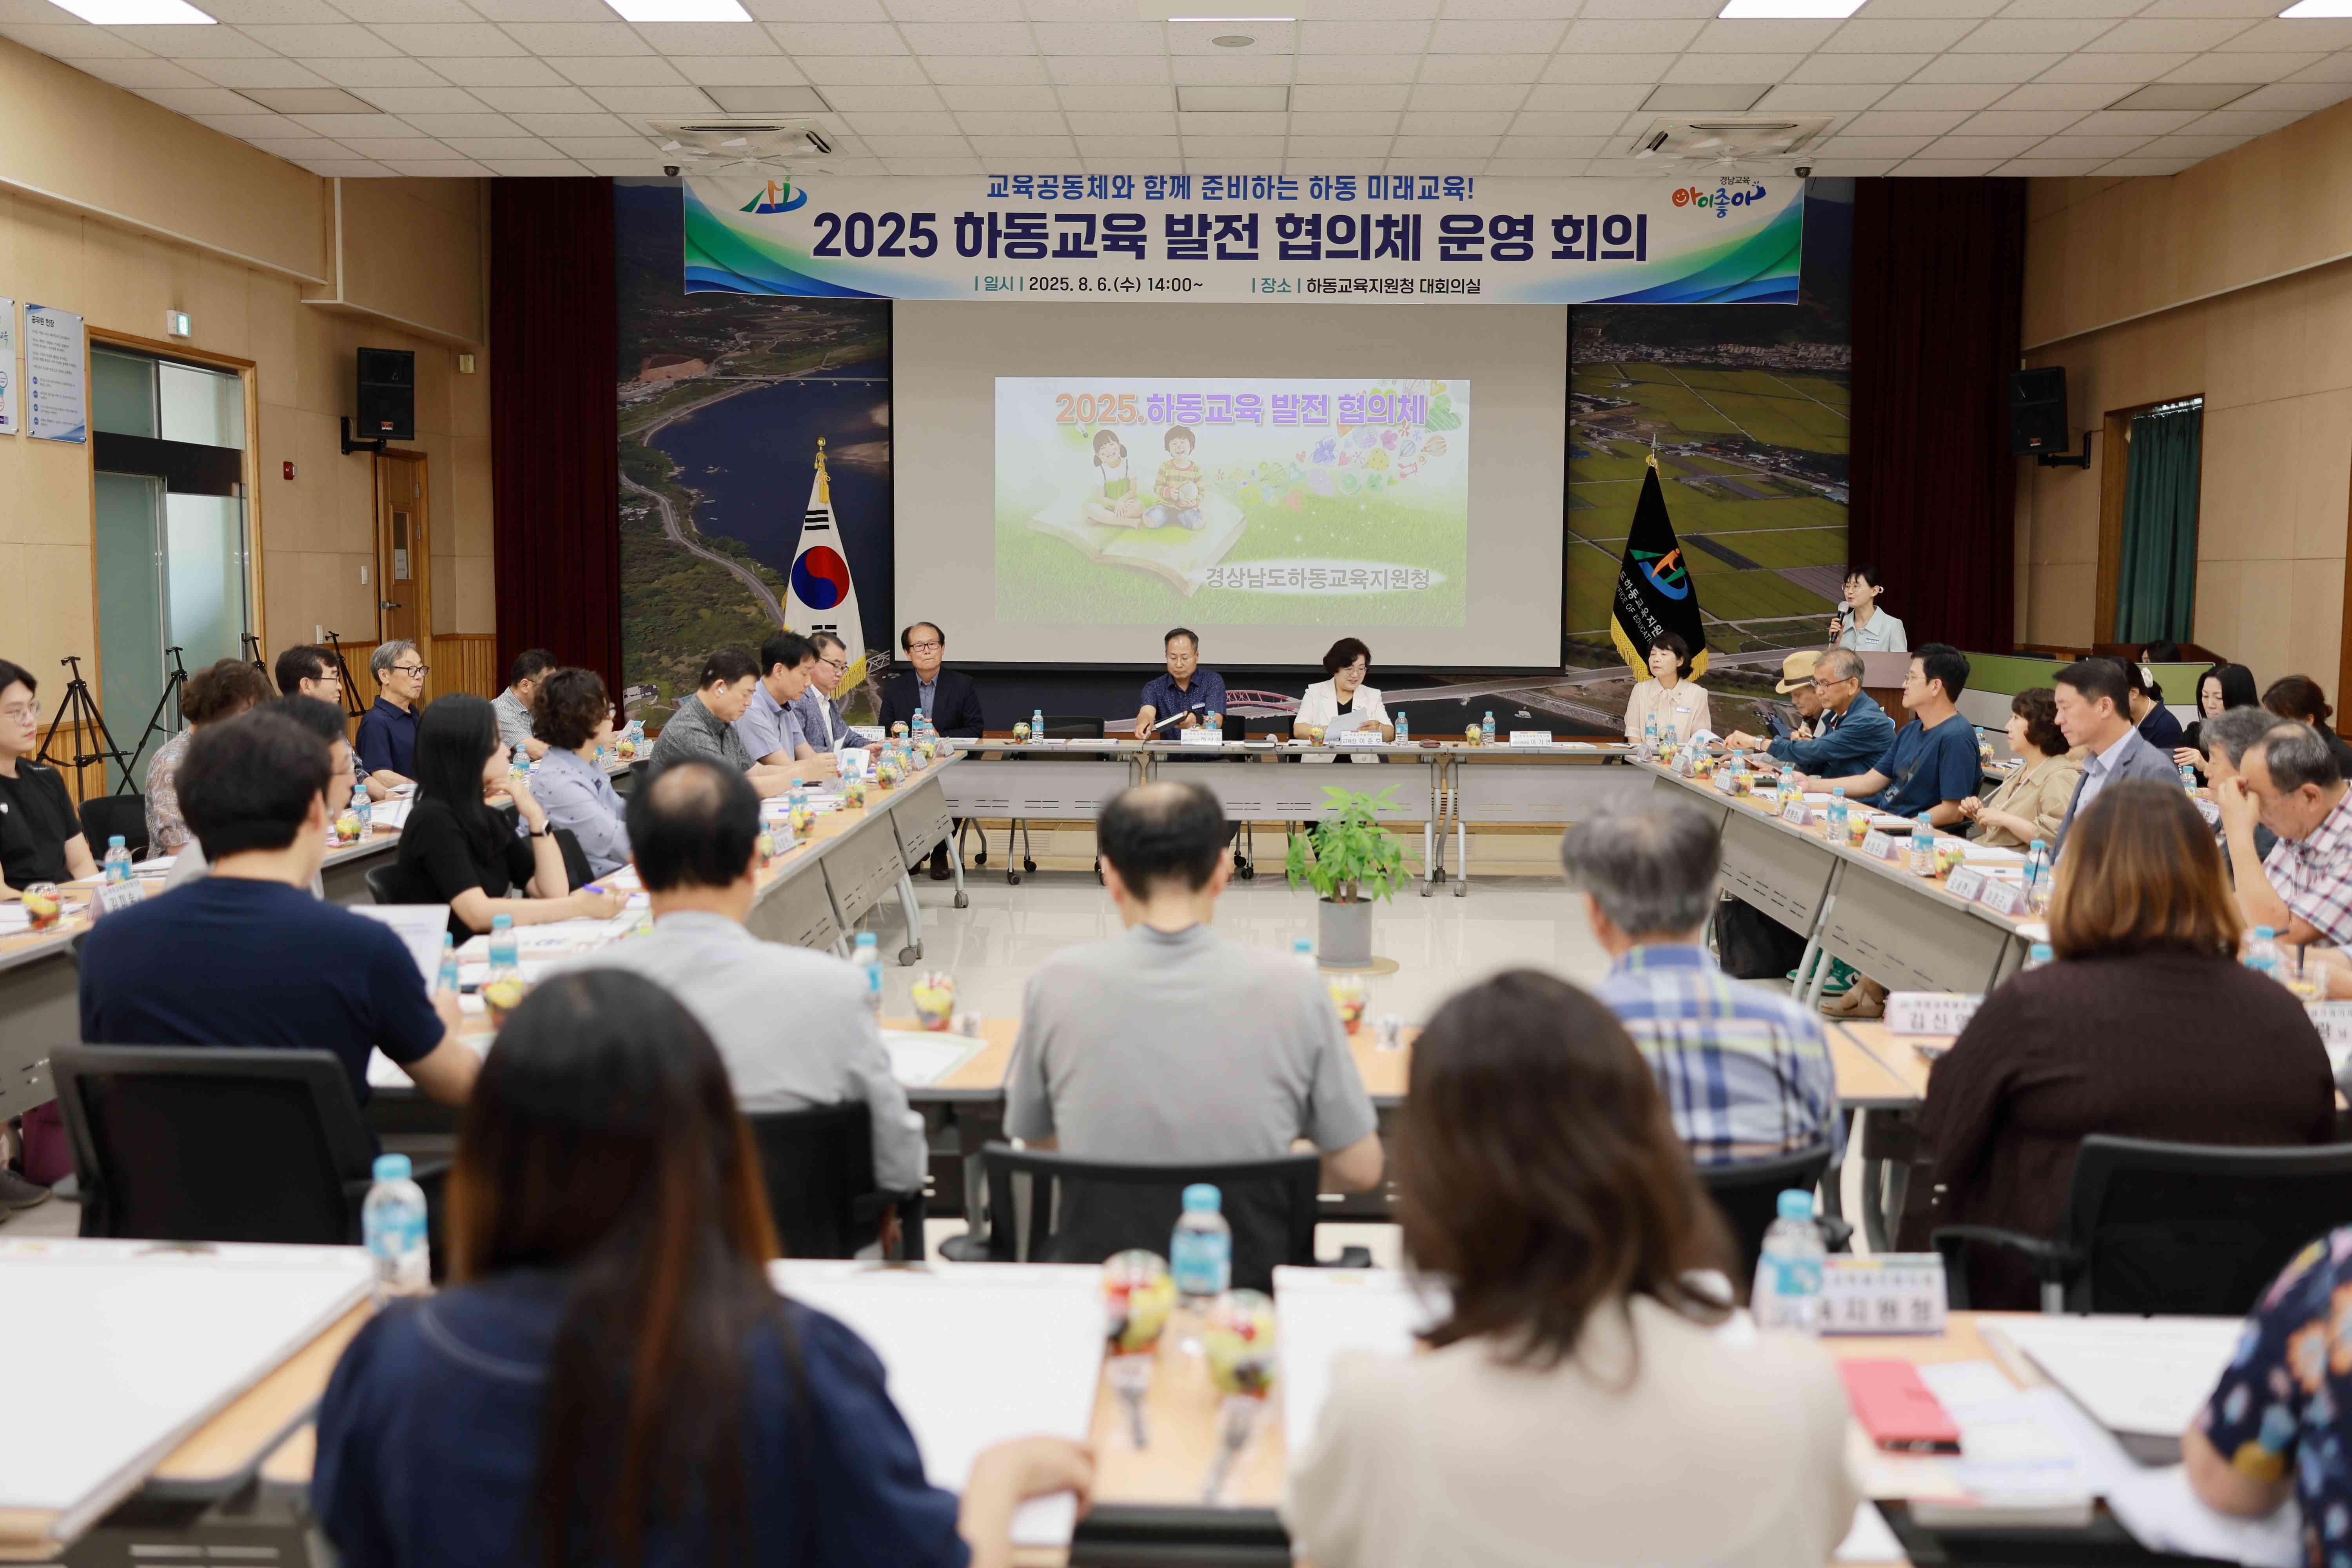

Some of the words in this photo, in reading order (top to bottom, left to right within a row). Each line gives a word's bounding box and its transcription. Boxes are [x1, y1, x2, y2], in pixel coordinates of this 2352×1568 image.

[987, 176, 1136, 200] 교육공동체와
[1144, 176, 1191, 200] 함께
[1202, 176, 1299, 201] 준비하는
[1310, 176, 1357, 201] 하동
[1368, 176, 1474, 201] 미래교육!
[1720, 176, 1750, 185] 경남교육
[1672, 187, 1766, 218] 아이좋아
[813, 212, 938, 258] 2025
[955, 212, 1147, 260] 하동교육
[1166, 214, 1259, 261] 발전
[1276, 213, 1421, 261] 협의체
[1439, 215, 1534, 261] 운영
[1552, 214, 1647, 262] 회의
[984, 276, 1013, 292] 일시
[1029, 277, 1074, 292] 2025.
[1079, 277, 1093, 292] 8.
[1098, 277, 1141, 293] 6.(수)
[1148, 278, 1203, 292] 14:00~
[1261, 278, 1292, 294] 장소
[1307, 278, 1414, 294] 하동교육지원청
[1420, 278, 1481, 294] 대회의실
[31, 315, 44, 326] 공무원
[45, 318, 54, 328] 헌장
[1271, 394, 1328, 424] 발전
[1338, 394, 1426, 425] 협의체
[1206, 567, 1430, 590] 경상남도하동교육지원청
[1626, 604, 1636, 613] OF
